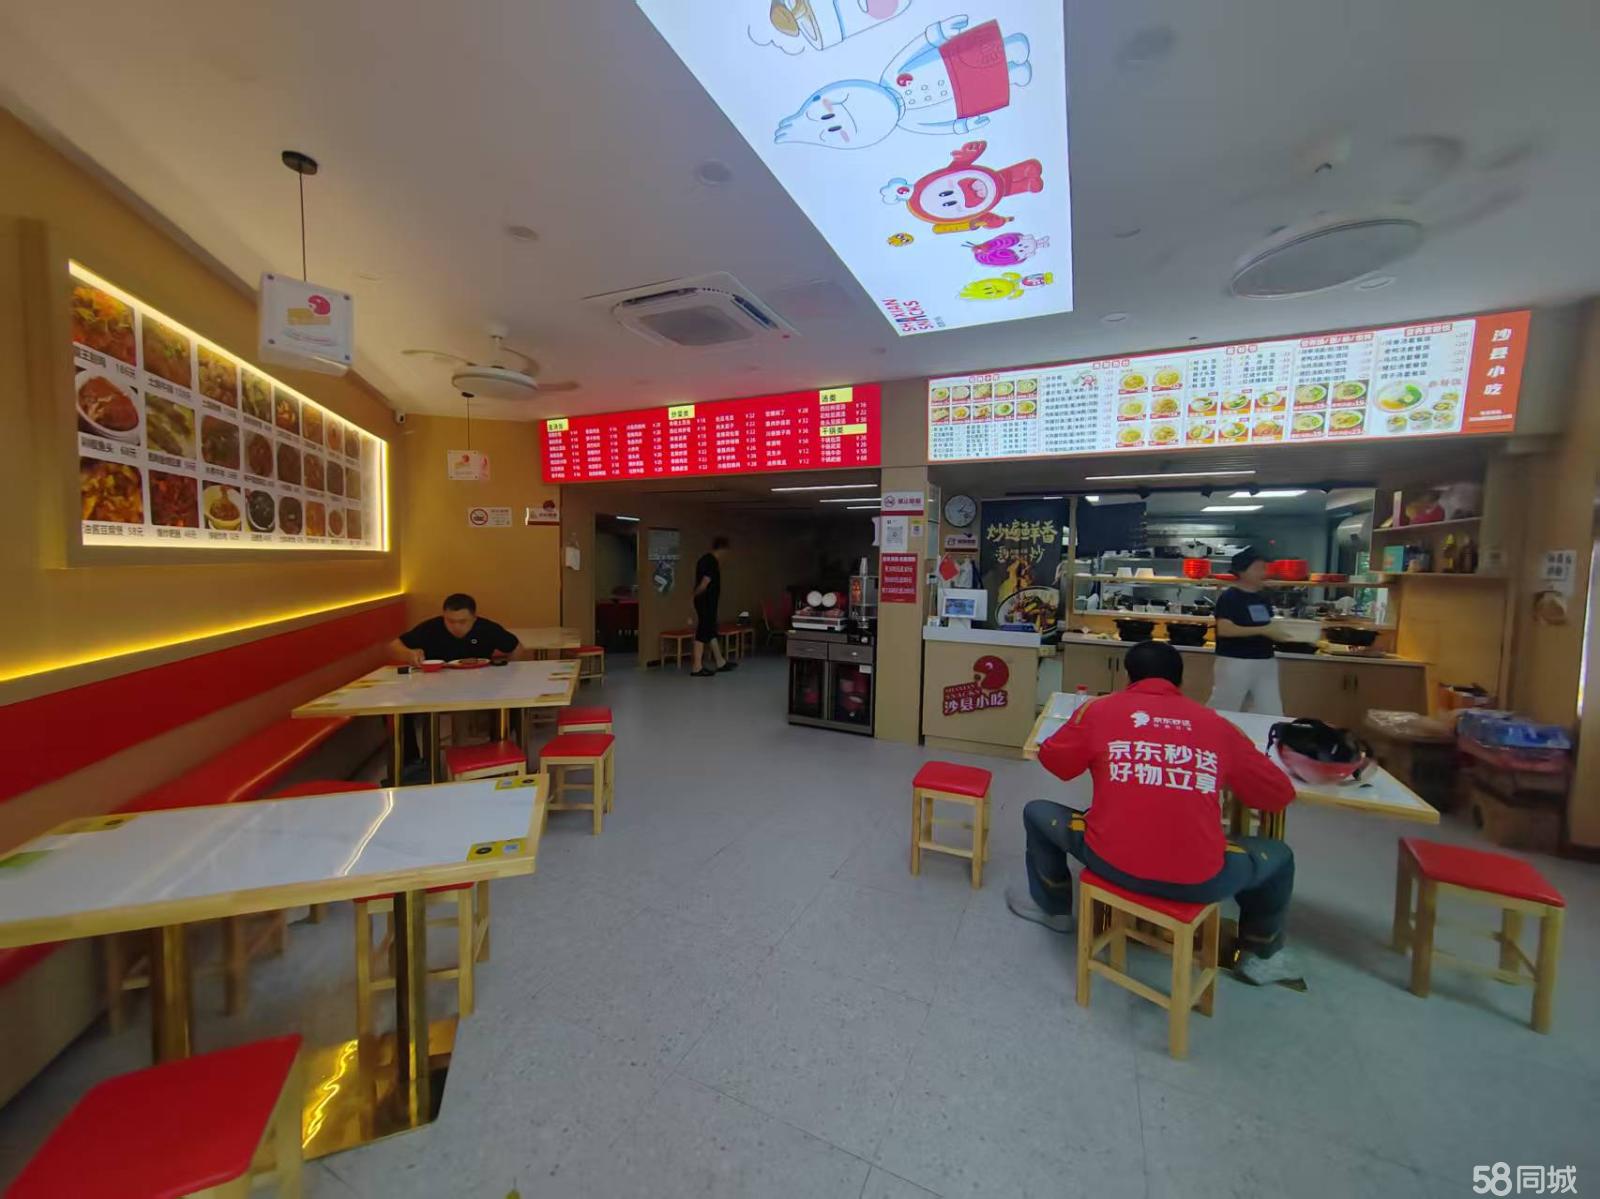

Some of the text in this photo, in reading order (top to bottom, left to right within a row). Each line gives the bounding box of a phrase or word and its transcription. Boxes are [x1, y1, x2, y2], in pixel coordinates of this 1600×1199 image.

[1484, 328, 1513, 396] 沙县小吃
[944, 691, 1006, 714] 沙县小吃
[1107, 740, 1218, 774] 京东秒送
[1109, 762, 1217, 794] 好物立享
